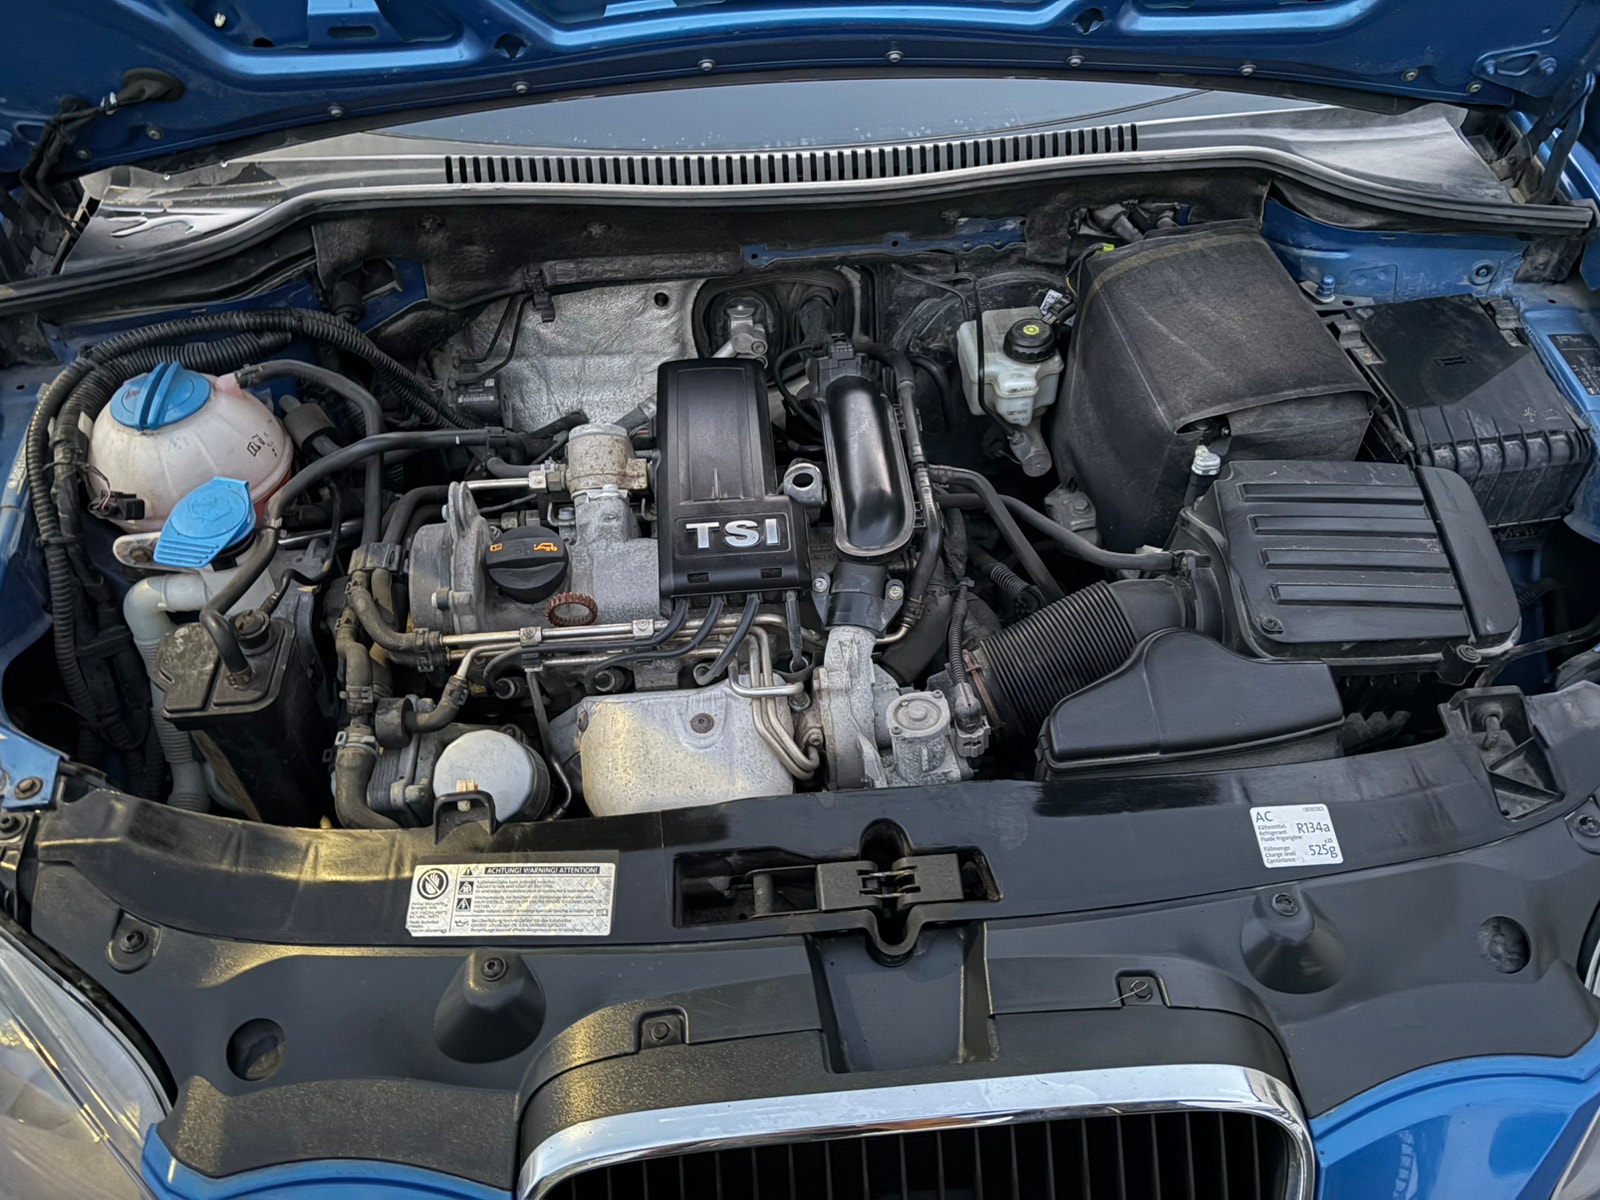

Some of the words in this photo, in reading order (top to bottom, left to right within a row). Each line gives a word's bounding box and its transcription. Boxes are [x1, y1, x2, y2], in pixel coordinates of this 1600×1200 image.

[685, 518, 779, 548] TSI
[1255, 810, 1273, 823] AC
[1296, 821, 1331, 834] R134a
[1308, 843, 1338, 859] 525g
[523, 866, 558, 874] WARNING!
[559, 866, 598, 874] ATTENTION!
